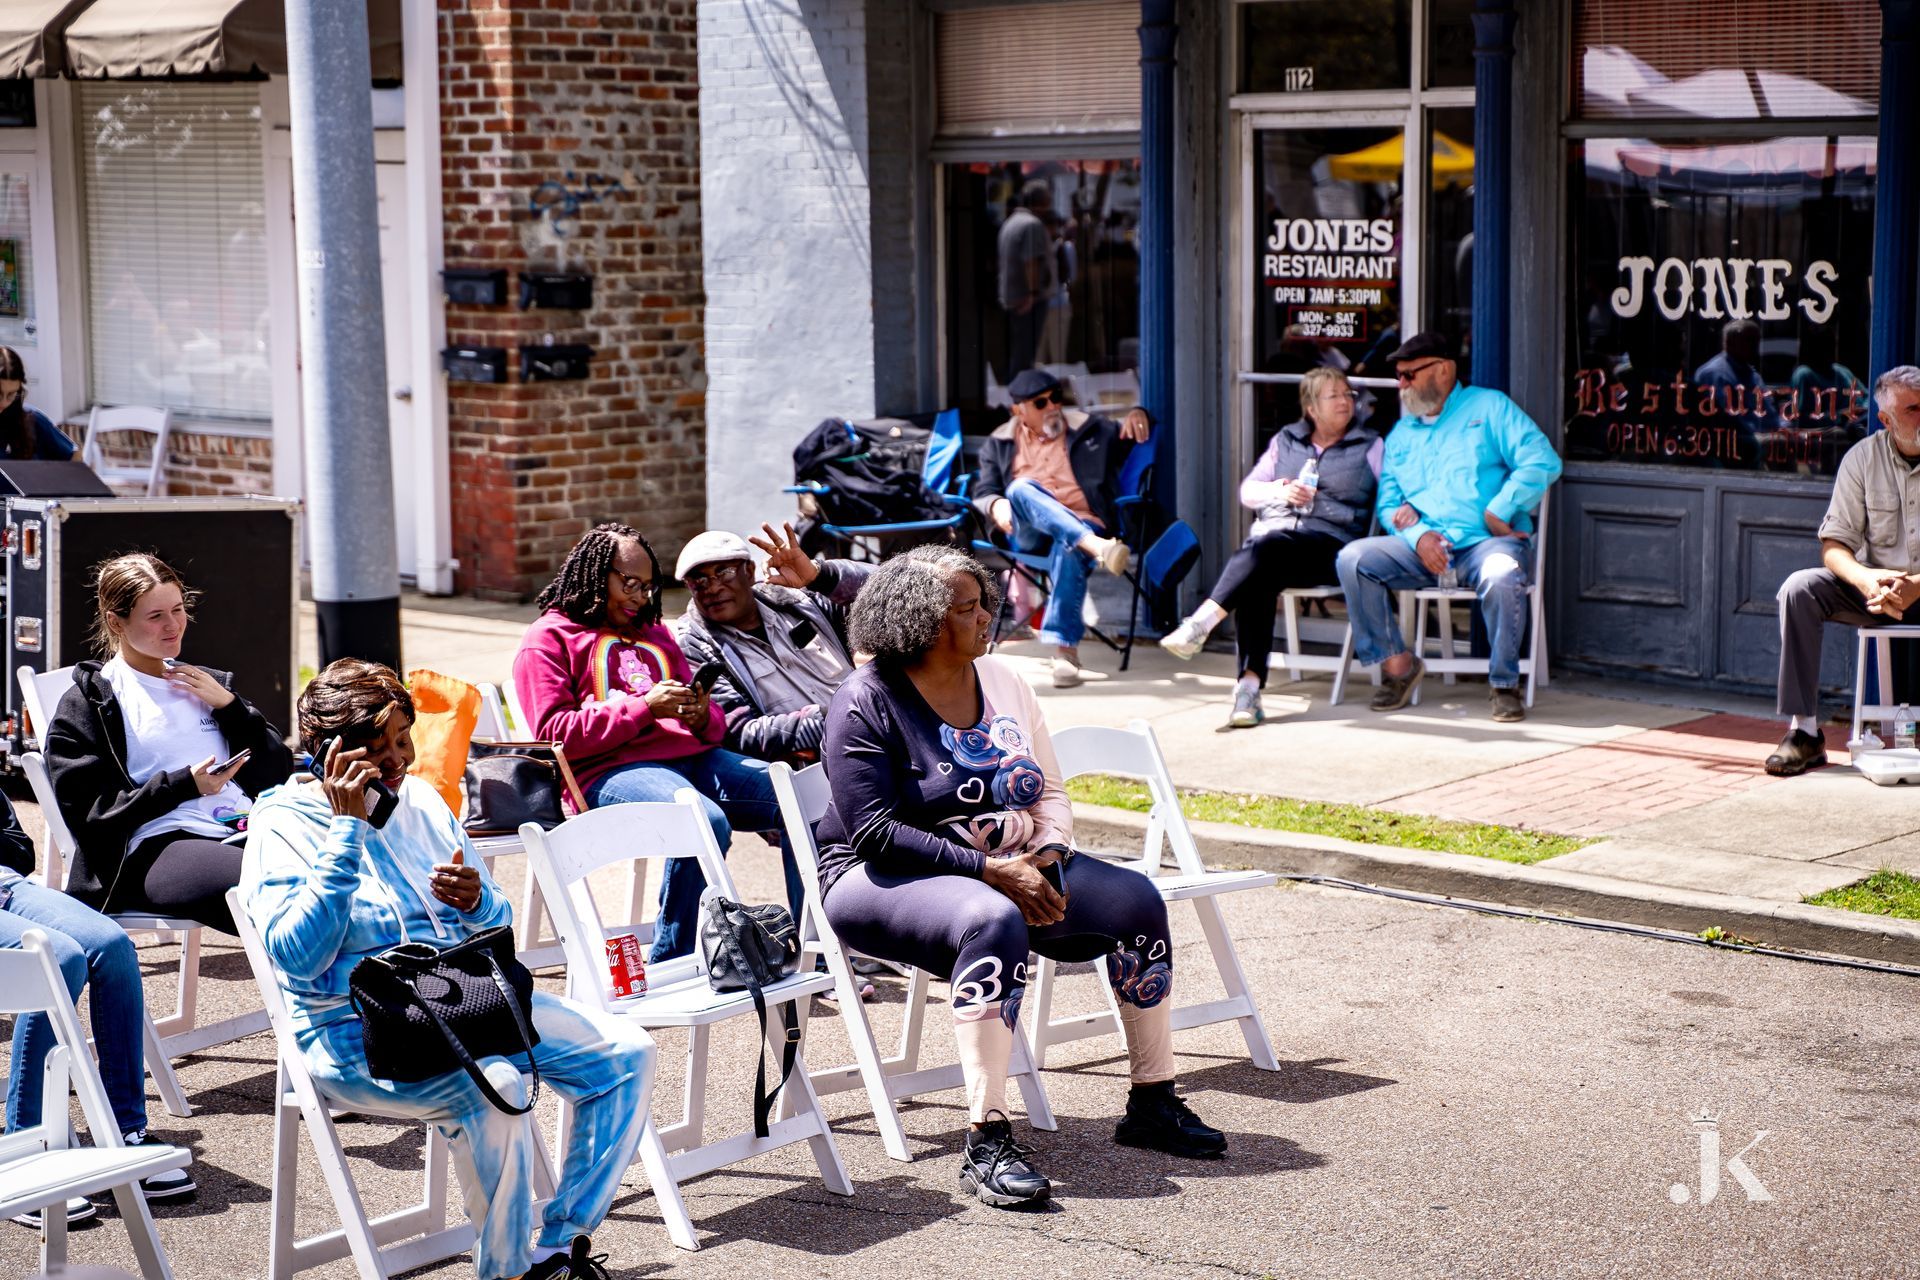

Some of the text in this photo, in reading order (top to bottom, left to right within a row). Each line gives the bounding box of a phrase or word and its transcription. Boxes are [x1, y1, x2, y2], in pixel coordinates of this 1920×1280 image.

[1287, 69, 1313, 89] 112
[1268, 218, 1394, 252] JONES
[1264, 254, 1396, 279] RESTAURANT
[1274, 286, 1306, 304] OPEN
[1611, 255, 1839, 324] JONES
[1607, 423, 1658, 455] OPEN
